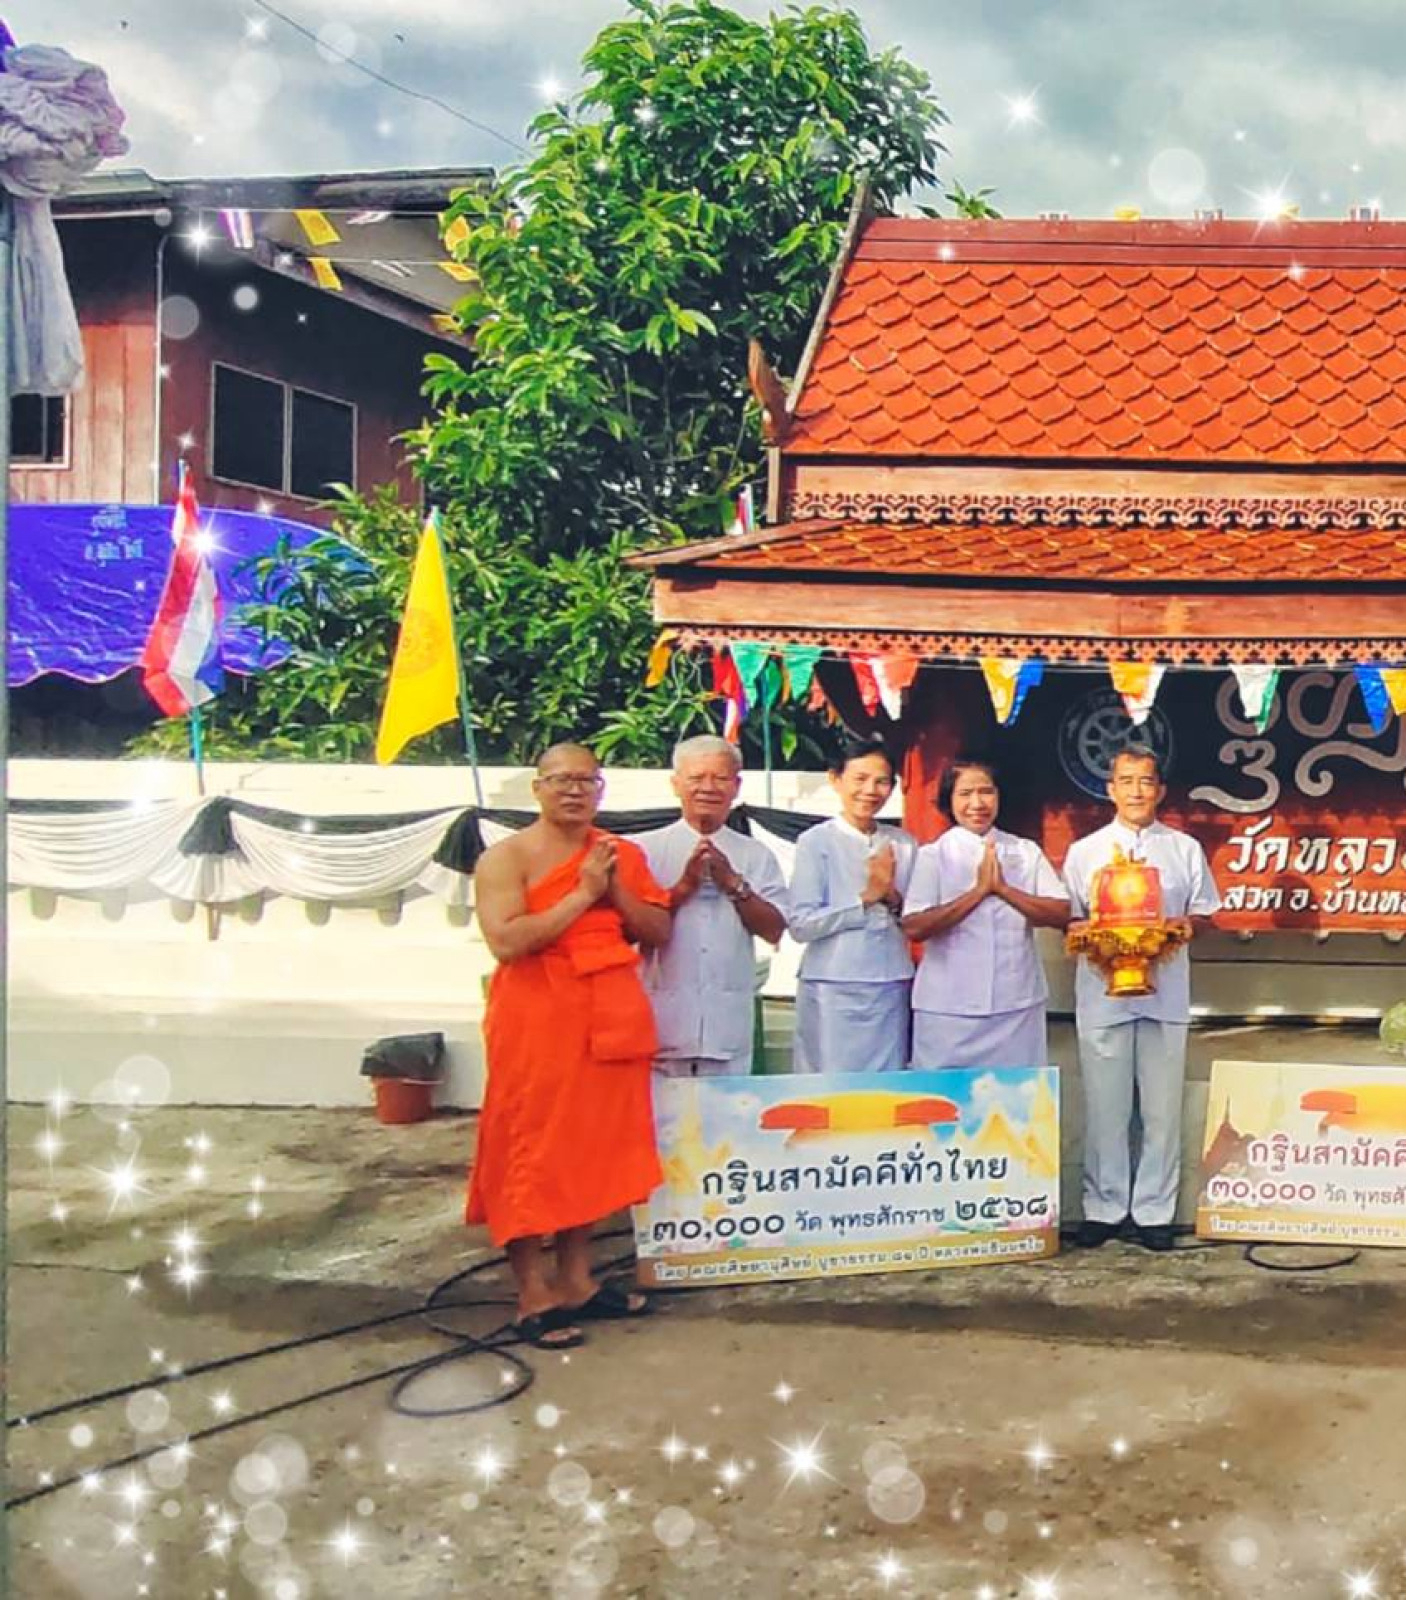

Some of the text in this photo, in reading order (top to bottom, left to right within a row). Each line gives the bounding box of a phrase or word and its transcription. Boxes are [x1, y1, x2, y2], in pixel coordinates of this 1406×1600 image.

[701, 1142, 1009, 1206] กฐินสามัคคีทั่วไทย
[1209, 1180, 1317, 1204] ๓๐,๐๐๐
[1324, 1184, 1347, 1204] วัด
[653, 1190, 1049, 1243] ๓๐,๐๐๐ วัด พุทธศักราช ๒๕๖๘
